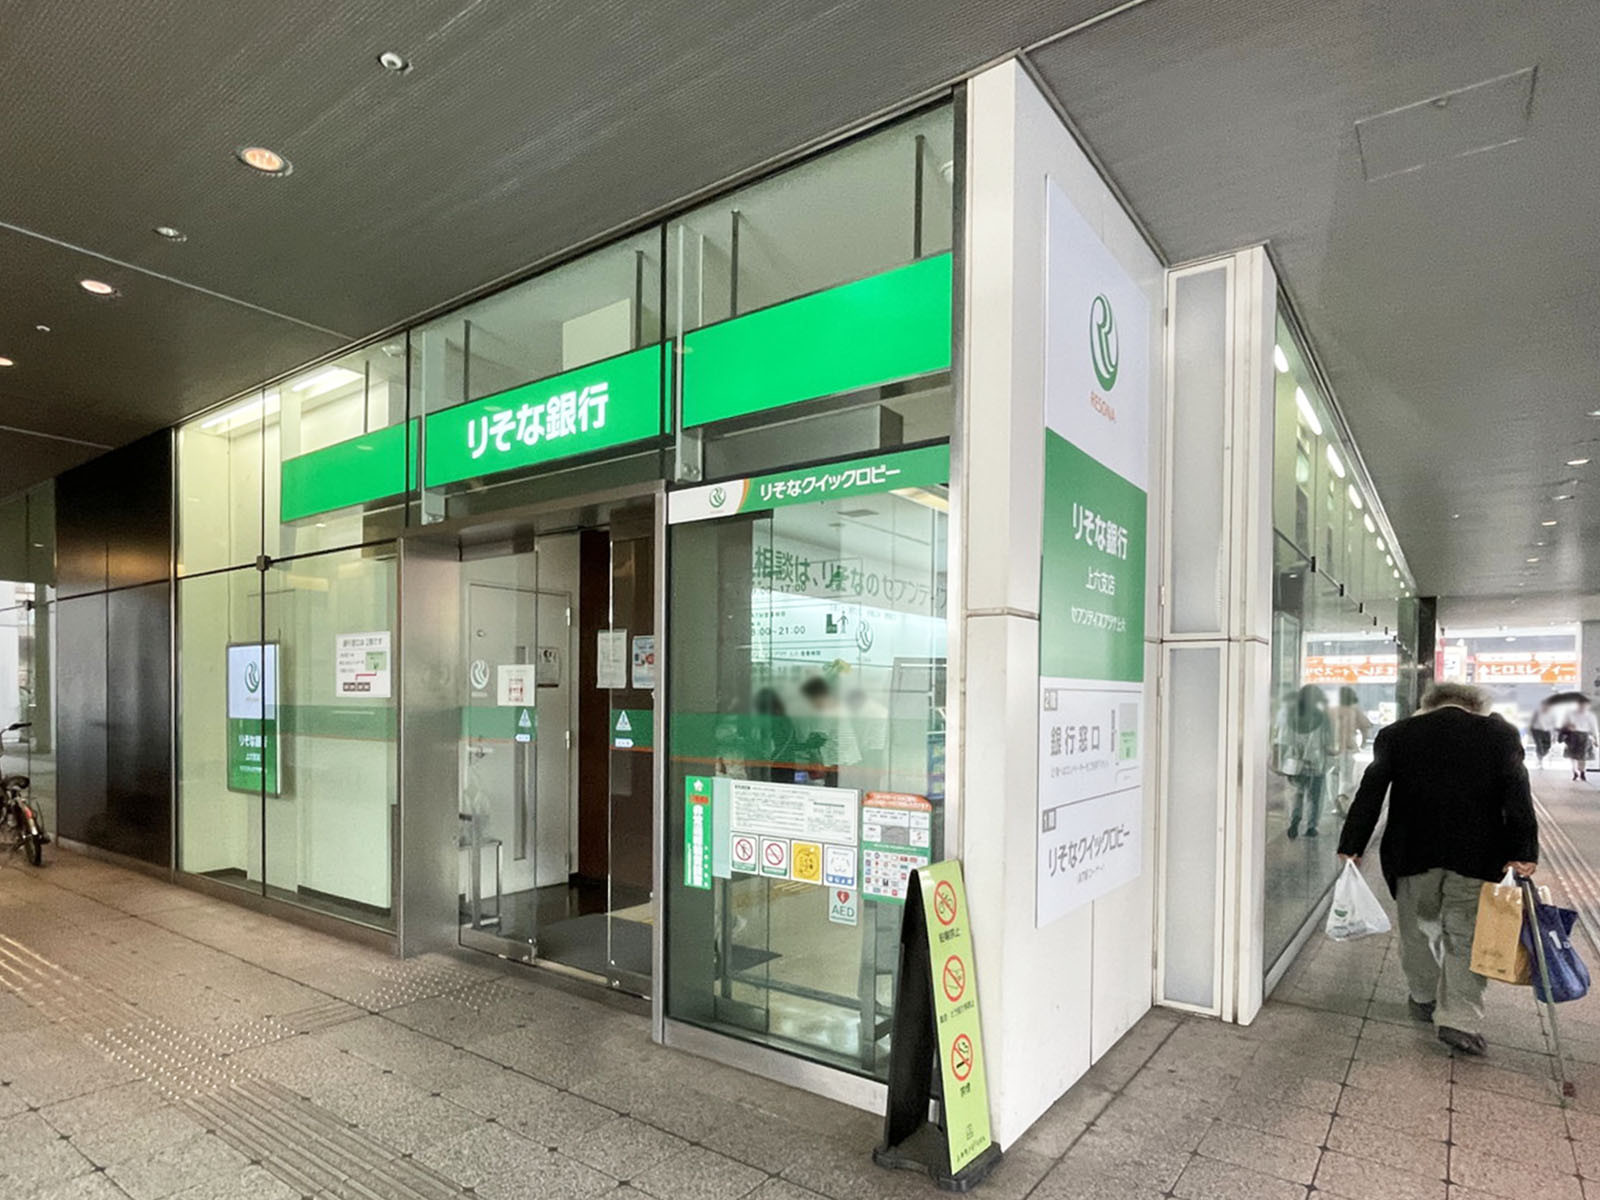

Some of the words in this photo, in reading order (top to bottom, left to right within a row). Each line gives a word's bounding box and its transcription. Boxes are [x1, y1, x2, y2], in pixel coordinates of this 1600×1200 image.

[467, 381, 609, 459] りそな銀行
[760, 465, 901, 500] りそなクイックロビー
[1072, 502, 1128, 561] りそな銀行
[1049, 824, 1131, 877] りそなクイックロビー
[831, 904, 855, 918] AED
